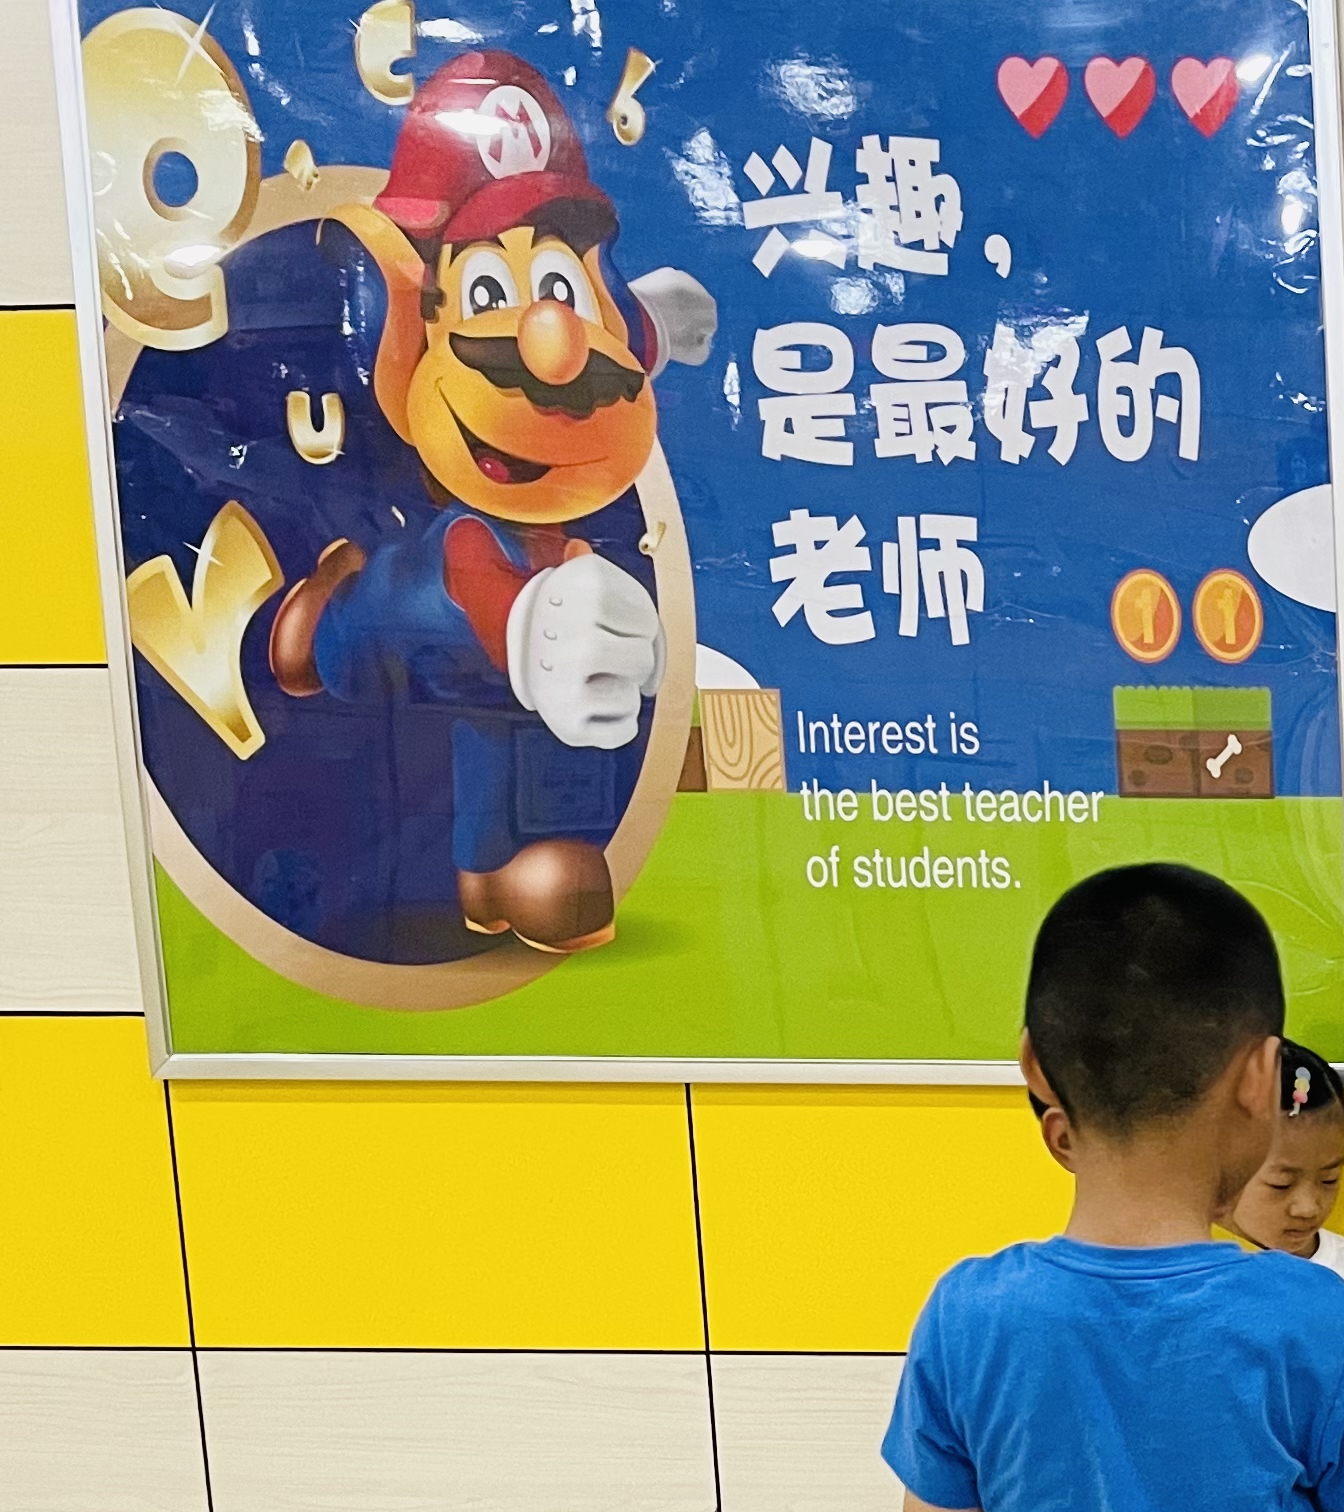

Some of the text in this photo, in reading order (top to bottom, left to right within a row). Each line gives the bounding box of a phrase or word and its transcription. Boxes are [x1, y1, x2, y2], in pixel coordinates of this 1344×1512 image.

[752, 320, 1202, 467] 是最好的
[770, 509, 985, 646] 老师
[798, 712, 980, 755] Interest is
[800, 780, 1105, 823] the best teacher
[806, 846, 1022, 890] of students.
